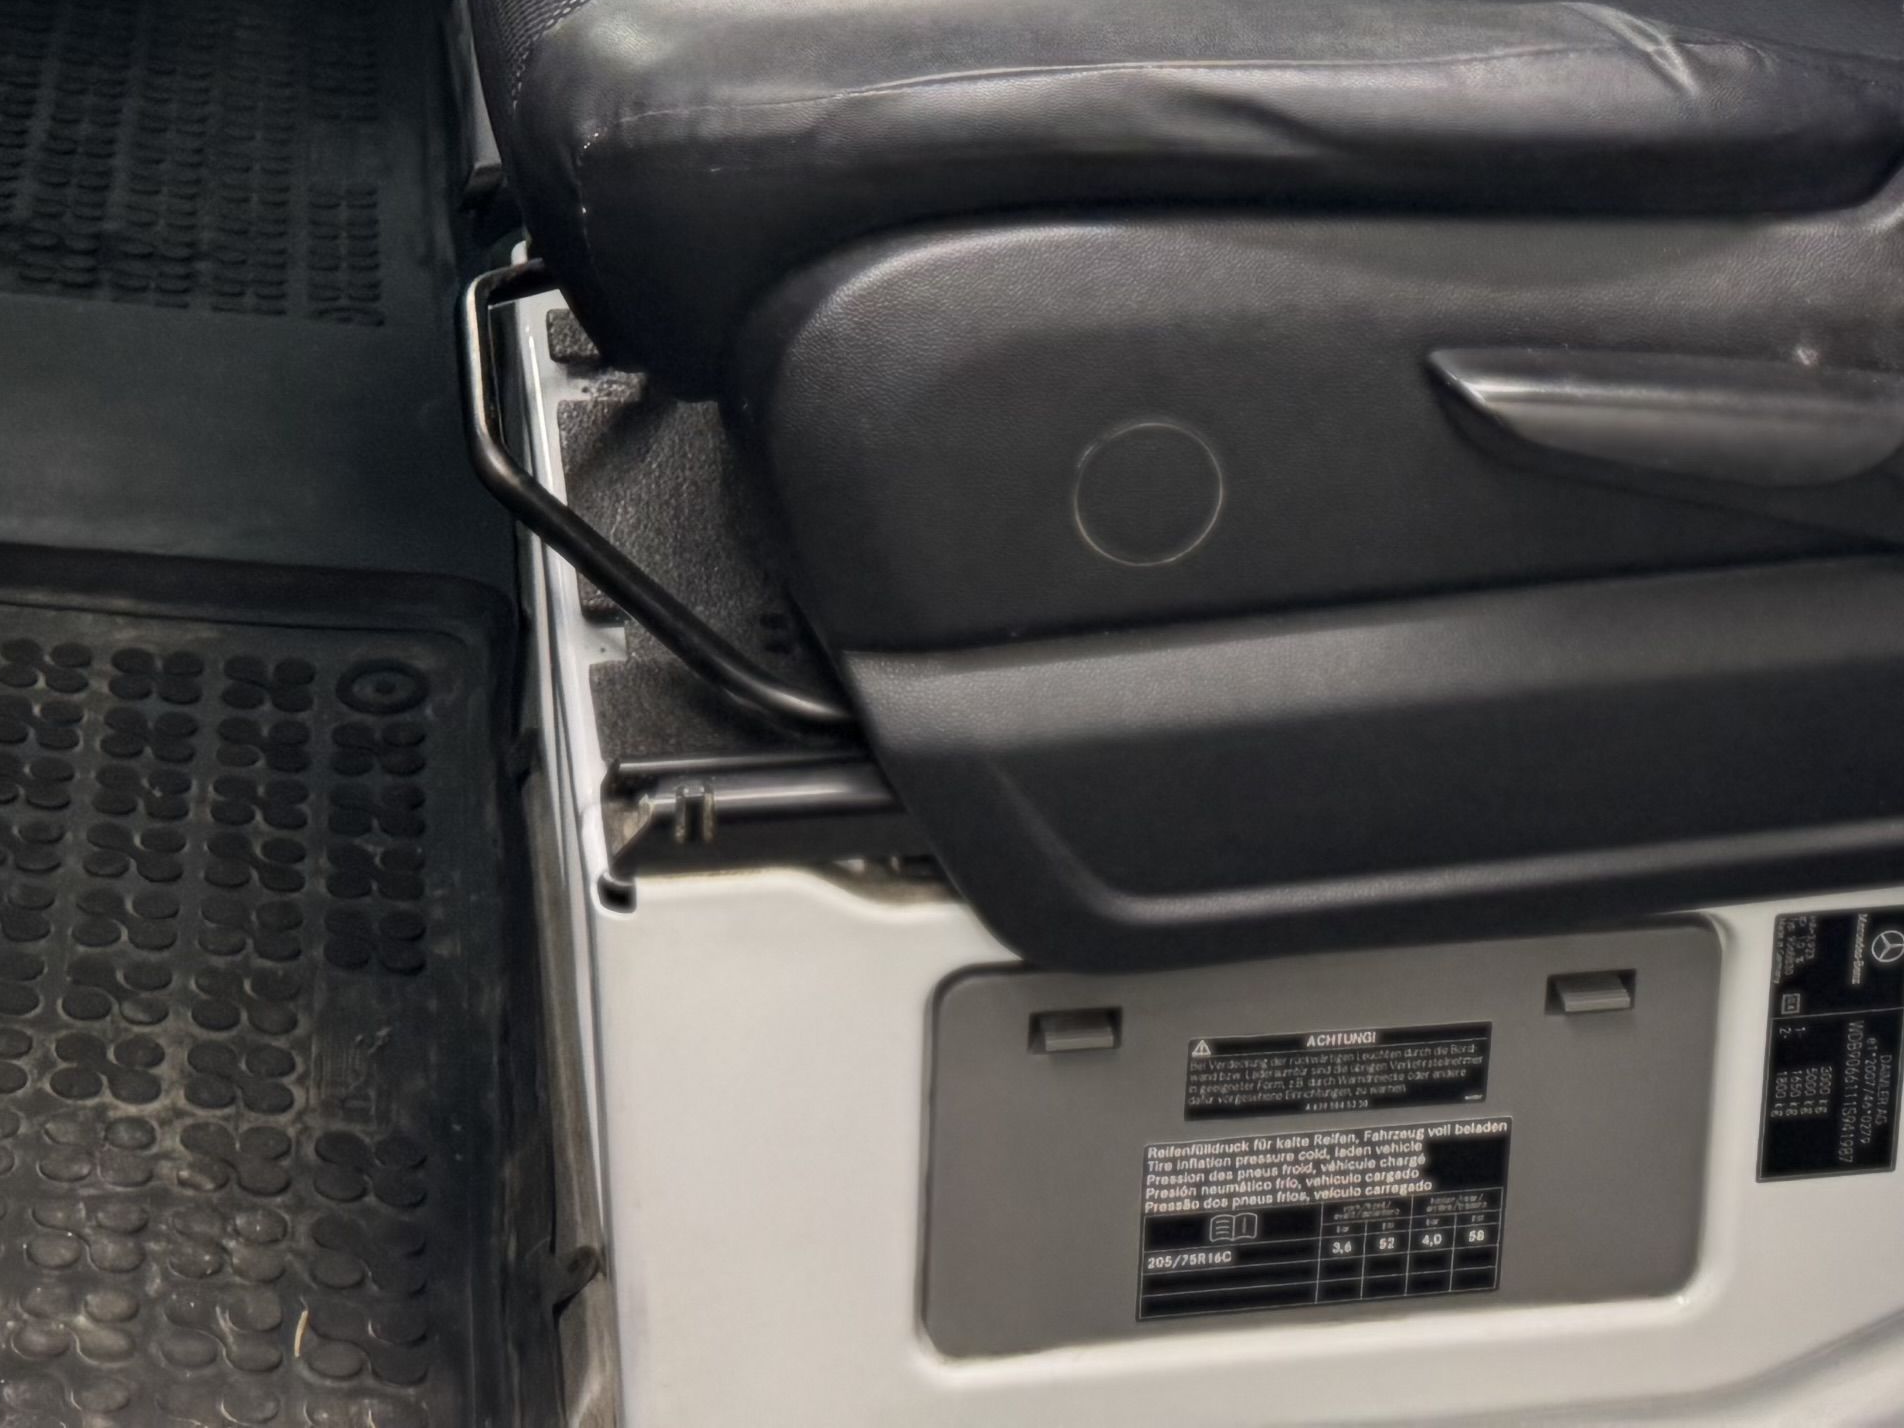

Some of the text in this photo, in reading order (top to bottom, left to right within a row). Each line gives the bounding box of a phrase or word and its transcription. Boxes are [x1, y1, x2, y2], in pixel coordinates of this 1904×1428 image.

[1851, 913, 1867, 984] Mercedes-Benz
[1306, 1031, 1376, 1047] ACHTUNG!
[1874, 1054, 1892, 1125] DAIMLER AG
[1147, 1120, 1507, 1158] Reifenfülldruck für kalte Reifen, Fahrzeug voll beladen
[1147, 1140, 1422, 1172] Tire inflation pressure cold, laden vehicle
[1145, 1184, 1196, 1199] Presión
[1201, 1179, 1272, 1195] neumático
[1365, 1167, 1419, 1183] cargado
[1146, 1171, 1205, 1186] Pression
[1208, 1169, 1233, 1182] des
[1236, 1166, 1278, 1181] pneus
[1281, 1161, 1316, 1175] froid,
[1379, 1152, 1426, 1168] chargé
[1144, 1198, 1199, 1213] Pressão
[1202, 1196, 1228, 1209] dos
[1231, 1194, 1273, 1209] pneus
[1364, 1179, 1432, 1196] carregado
[1147, 1250, 1231, 1269] 205/75R16C
[1378, 1236, 1395, 1250] 52
[1421, 1233, 1442, 1247] 4,0
